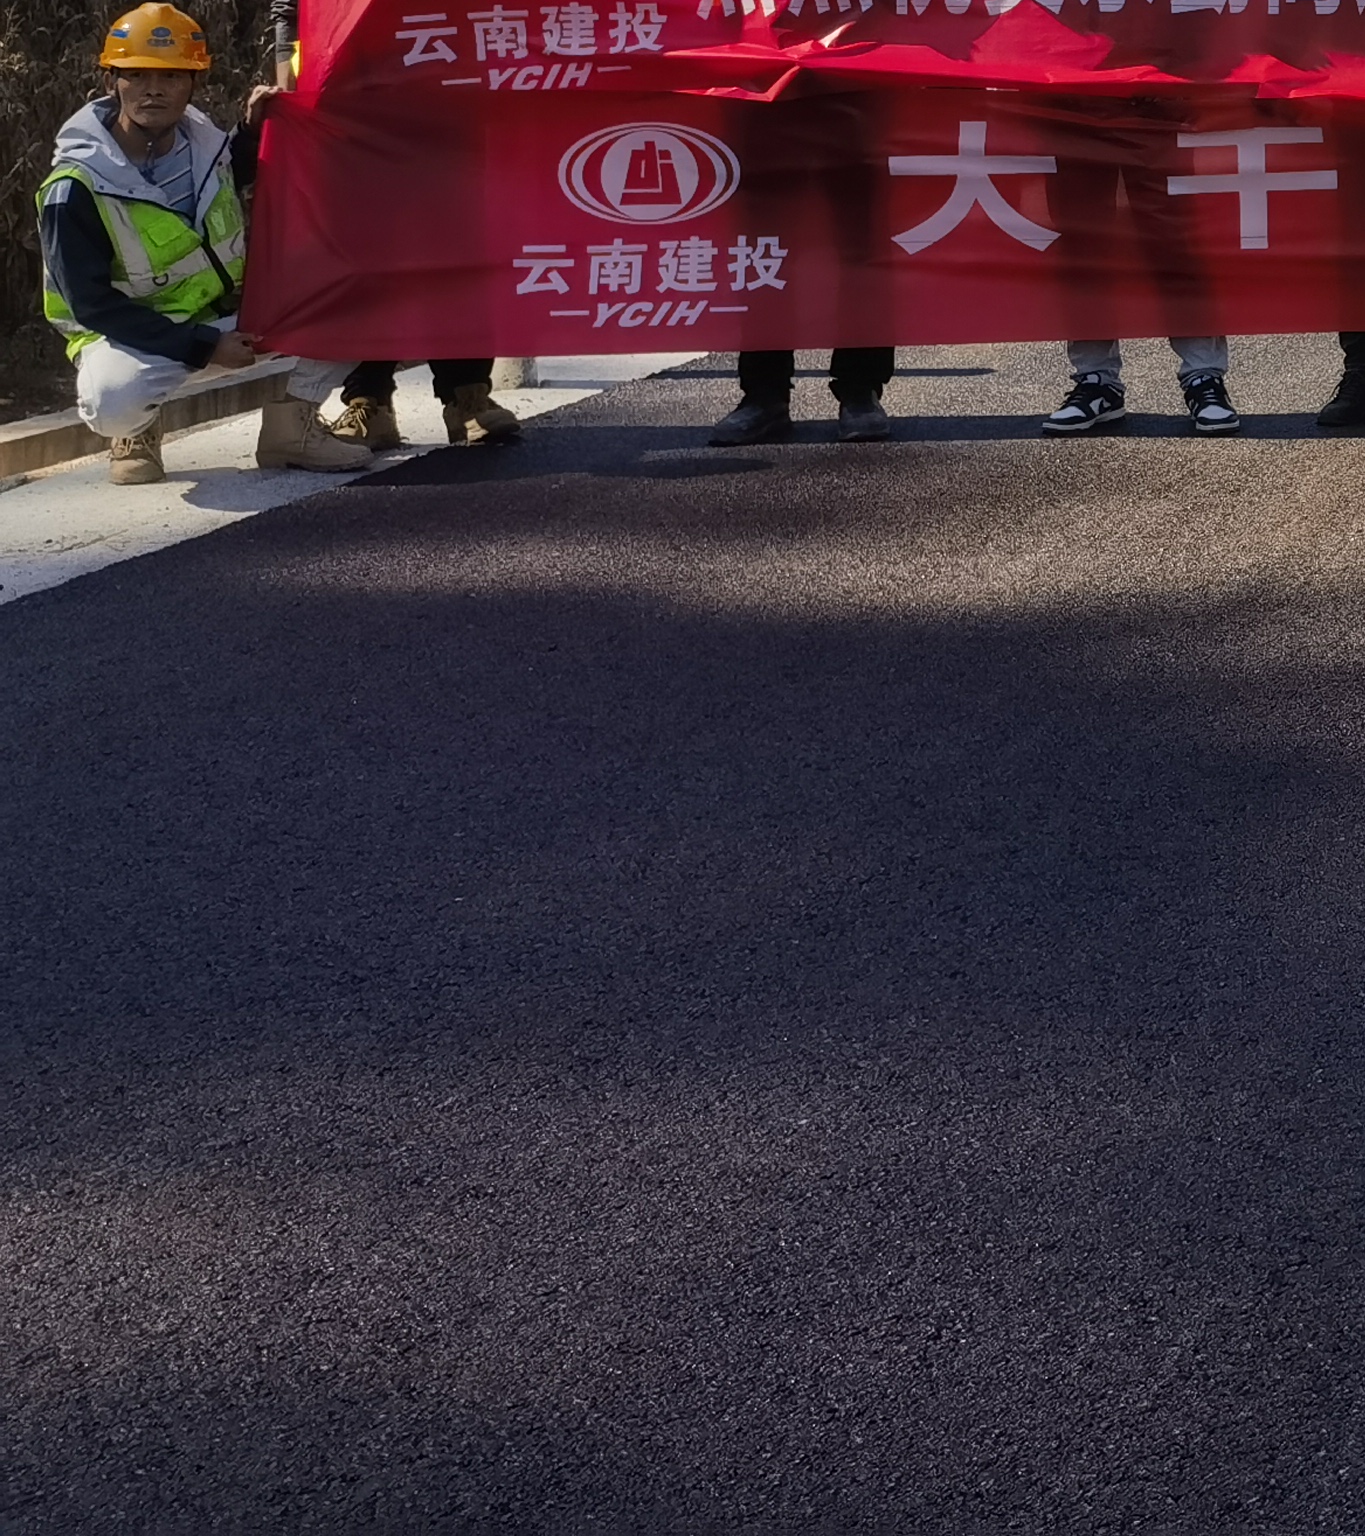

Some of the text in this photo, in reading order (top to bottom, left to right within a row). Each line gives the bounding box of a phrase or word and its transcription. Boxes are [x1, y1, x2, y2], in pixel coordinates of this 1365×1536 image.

[395, 2, 667, 66] 云南建投
[513, 235, 788, 295] 云南建投
